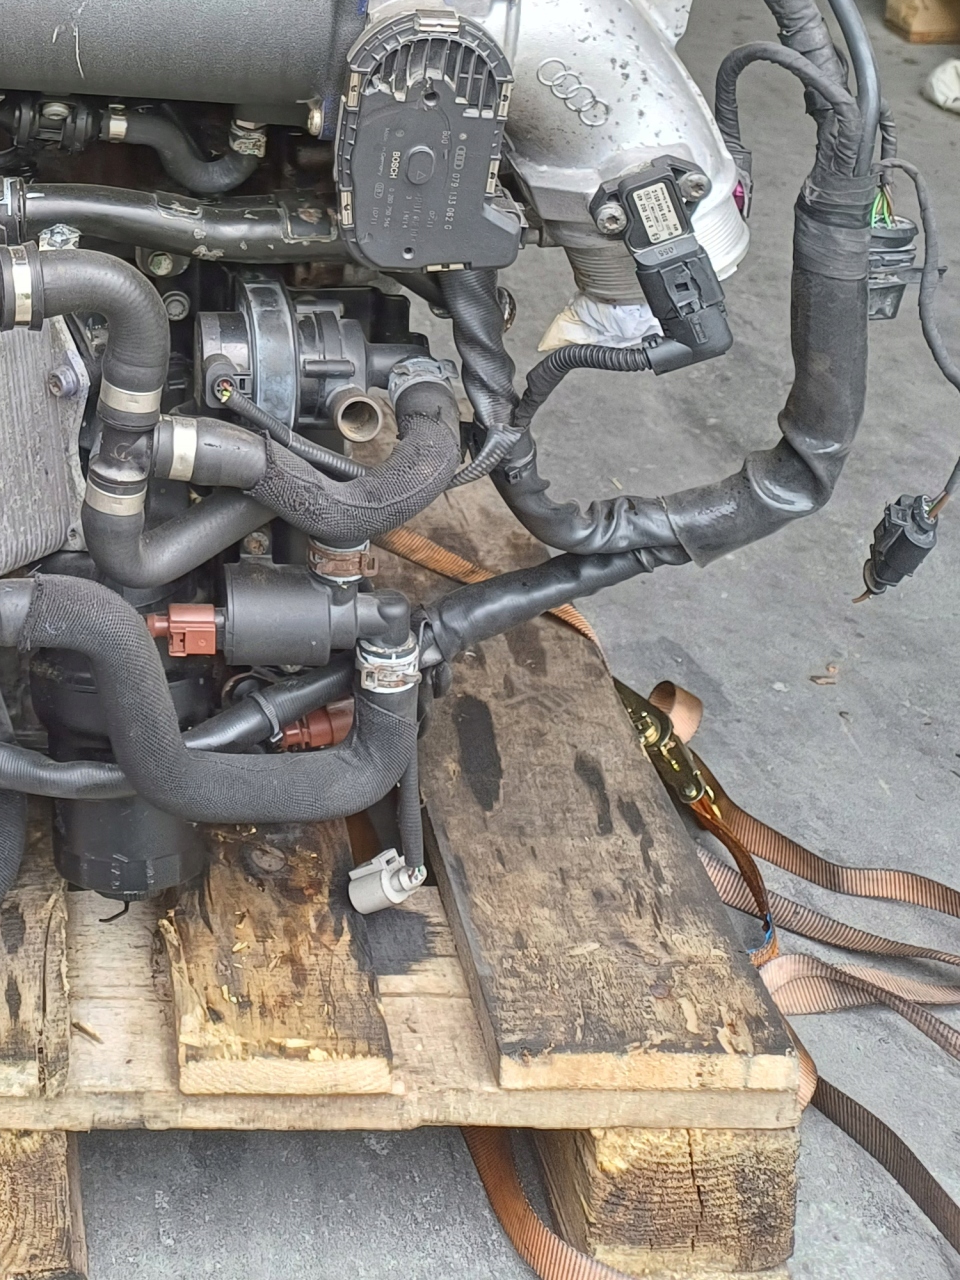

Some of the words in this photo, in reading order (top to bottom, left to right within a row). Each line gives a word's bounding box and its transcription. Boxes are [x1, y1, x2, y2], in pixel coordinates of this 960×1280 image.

[389, 151, 401, 179] BOSCH
[450, 173, 460, 187] 079
[447, 191, 458, 205] 133
[445, 207, 455, 222] 062
[657, 246, 674, 257] 055
